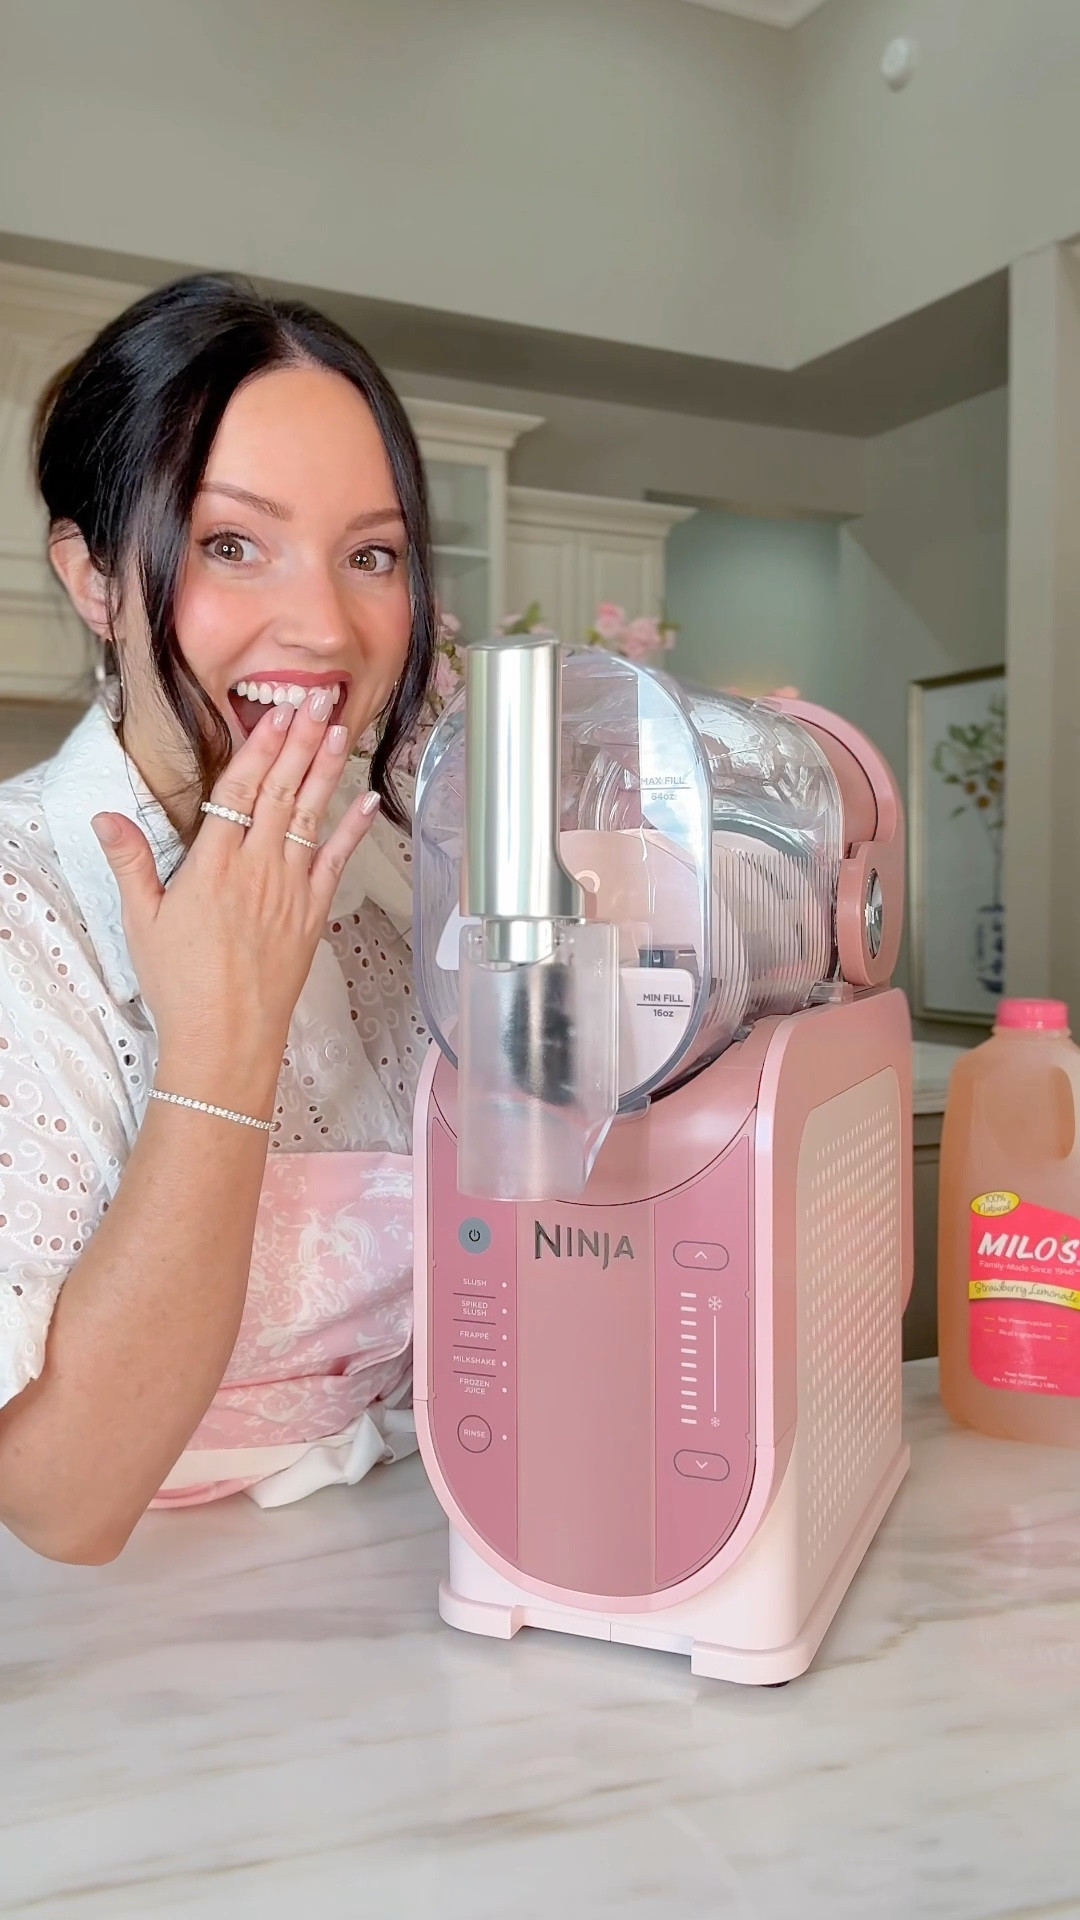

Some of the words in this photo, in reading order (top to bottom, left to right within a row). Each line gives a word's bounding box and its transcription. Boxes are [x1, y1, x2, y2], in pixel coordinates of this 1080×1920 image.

[641, 776, 662, 786] MAX
[664, 776, 685, 785] FILL
[651, 792, 677, 801] 64oz
[643, 994, 661, 1002] MIN
[663, 994, 684, 1003] FILL
[653, 1009, 674, 1018] 16oz
[985, 1194, 1007, 1203] 100%
[977, 1200, 1012, 1213] Natural
[534, 1220, 635, 1270] NINJA
[1031, 1265, 1053, 1275] Since
[462, 1278, 487, 1287] SLUSH
[974, 1281, 1028, 1298] Strawberry
[1029, 1283, 1080, 1304] Lemonade
[461, 1300, 489, 1309] SPIKED
[462, 1308, 487, 1317] SLUSH
[452, 1355, 497, 1366] MILKSHAKE
[459, 1377, 490, 1388] FROZEN
[464, 1386, 486, 1396] JUICE
[463, 1428, 486, 1438] RINSE
